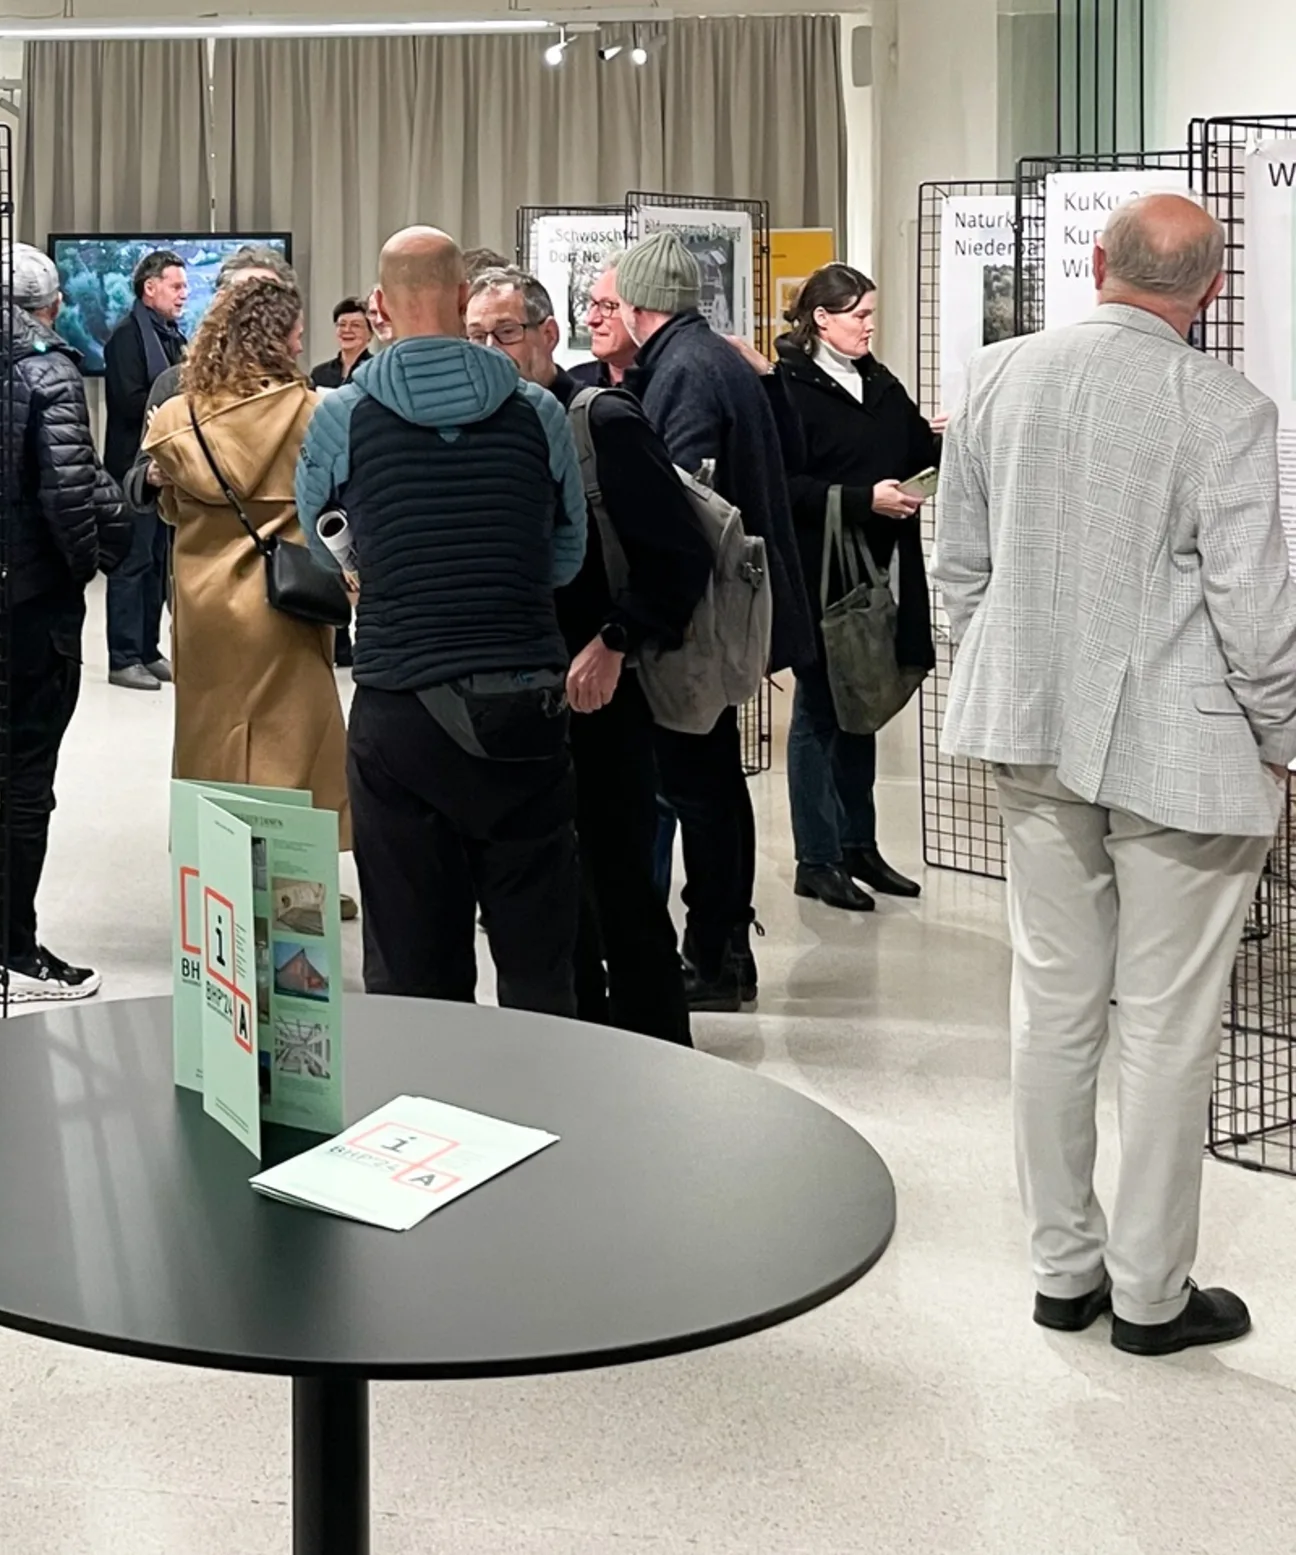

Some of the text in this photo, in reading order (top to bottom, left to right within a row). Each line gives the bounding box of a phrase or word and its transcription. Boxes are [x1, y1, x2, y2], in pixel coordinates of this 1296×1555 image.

[181, 957, 201, 981] BH
[239, 1003, 248, 1040] A
[408, 1173, 437, 1187] A
